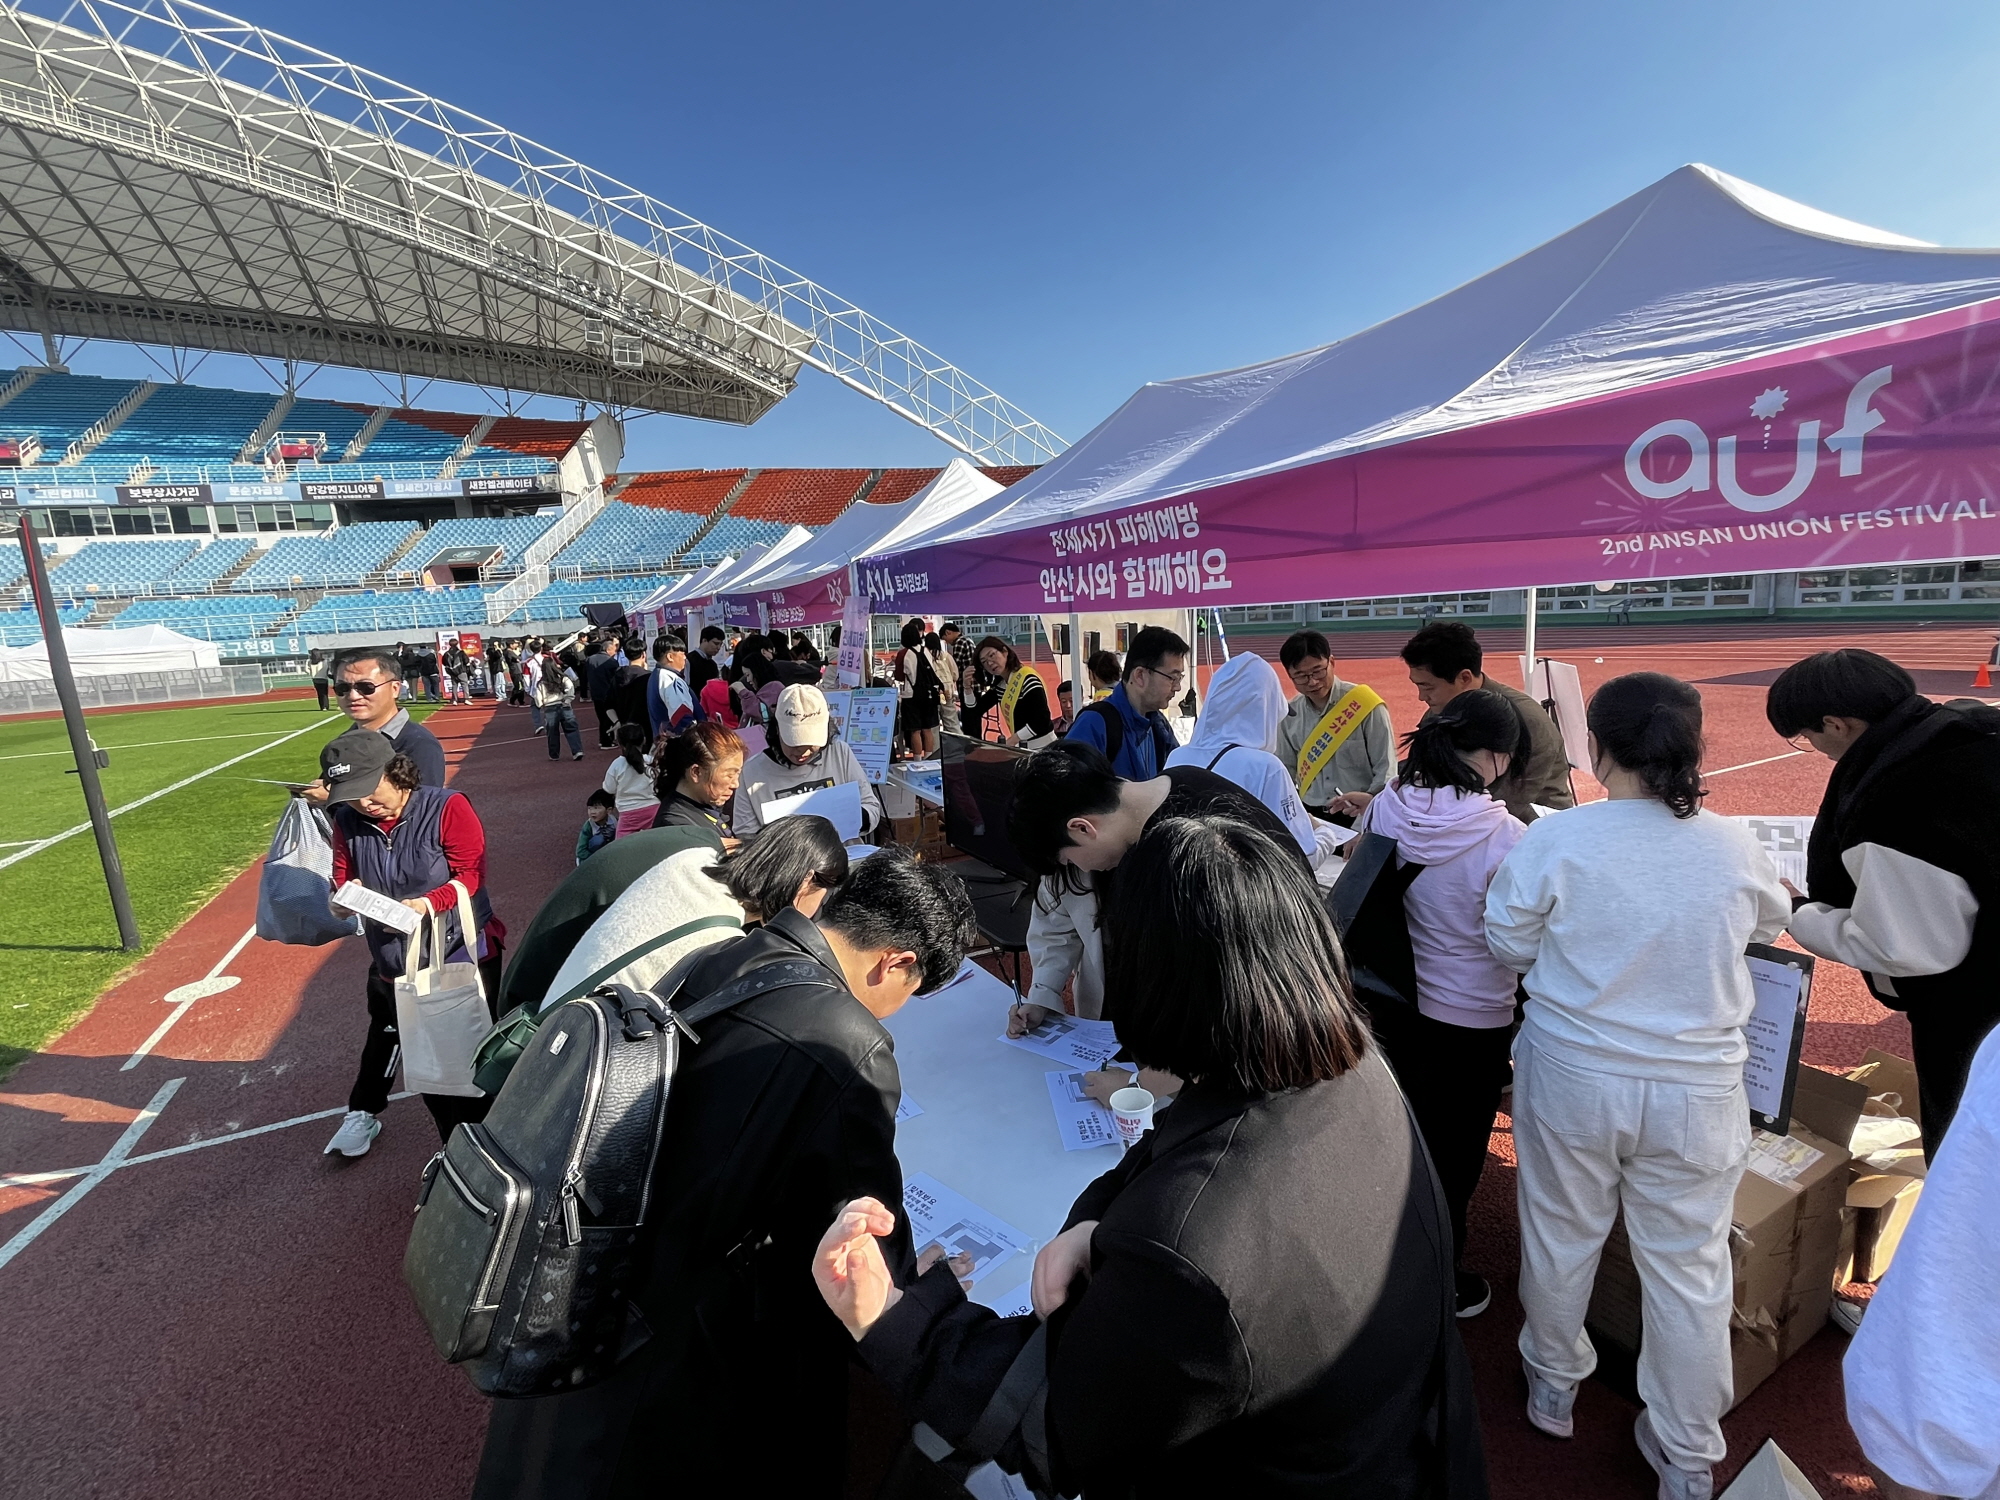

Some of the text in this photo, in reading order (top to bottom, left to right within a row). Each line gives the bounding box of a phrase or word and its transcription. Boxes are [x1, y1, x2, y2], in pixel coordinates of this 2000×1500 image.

[0, 489, 15, 500] 라
[128, 487, 200, 498] 보부상사거리
[305, 484, 378, 495] 한강엔지니어링
[1049, 502, 1200, 557] 전세사기 피해예방
[1600, 497, 1999, 556] 2nd ANSAN UNION FESTIVAL
[866, 567, 894, 602] A14
[894, 571, 929, 595] 토지정보과
[1039, 547, 1233, 603] 안산시와 함께해요
[1306, 699, 1362, 763] 전세사기 피해예방
[908, 1185, 937, 1206] 맞춰봐요
